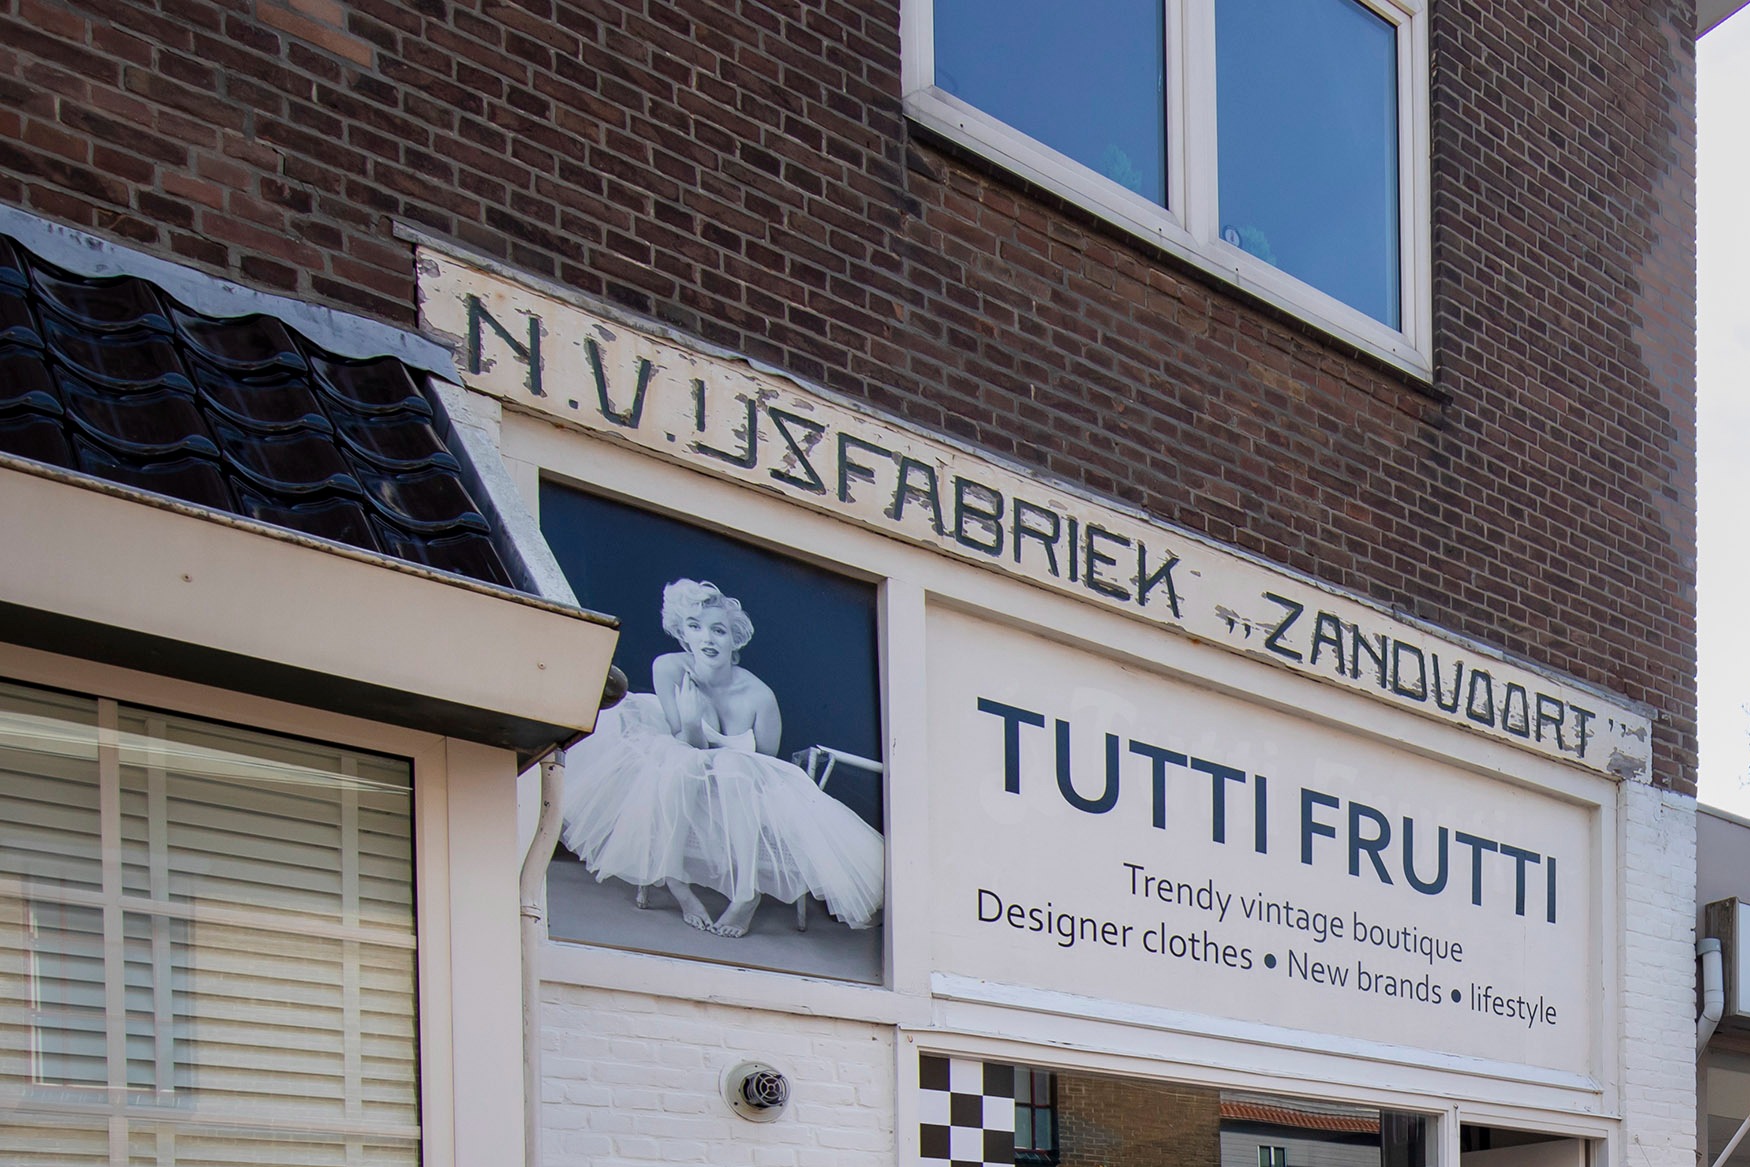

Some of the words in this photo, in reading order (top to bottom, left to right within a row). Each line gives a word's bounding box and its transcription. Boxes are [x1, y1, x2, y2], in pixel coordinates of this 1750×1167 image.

[690, 376, 1183, 618] IJSFABRIEK
[976, 696, 1268, 855] TUTTI
[1299, 787, 1558, 925] FRUTTI
[976, 888, 1133, 949] Designer
[1141, 920, 1254, 971] clothes
[1287, 949, 1349, 989] New
[1356, 961, 1443, 1006] brands
[1469, 982, 1558, 1028] lifestyle
[1122, 861, 1233, 922] Trendy
[1239, 892, 1345, 944] vintage
[1352, 911, 1464, 964] boutique
